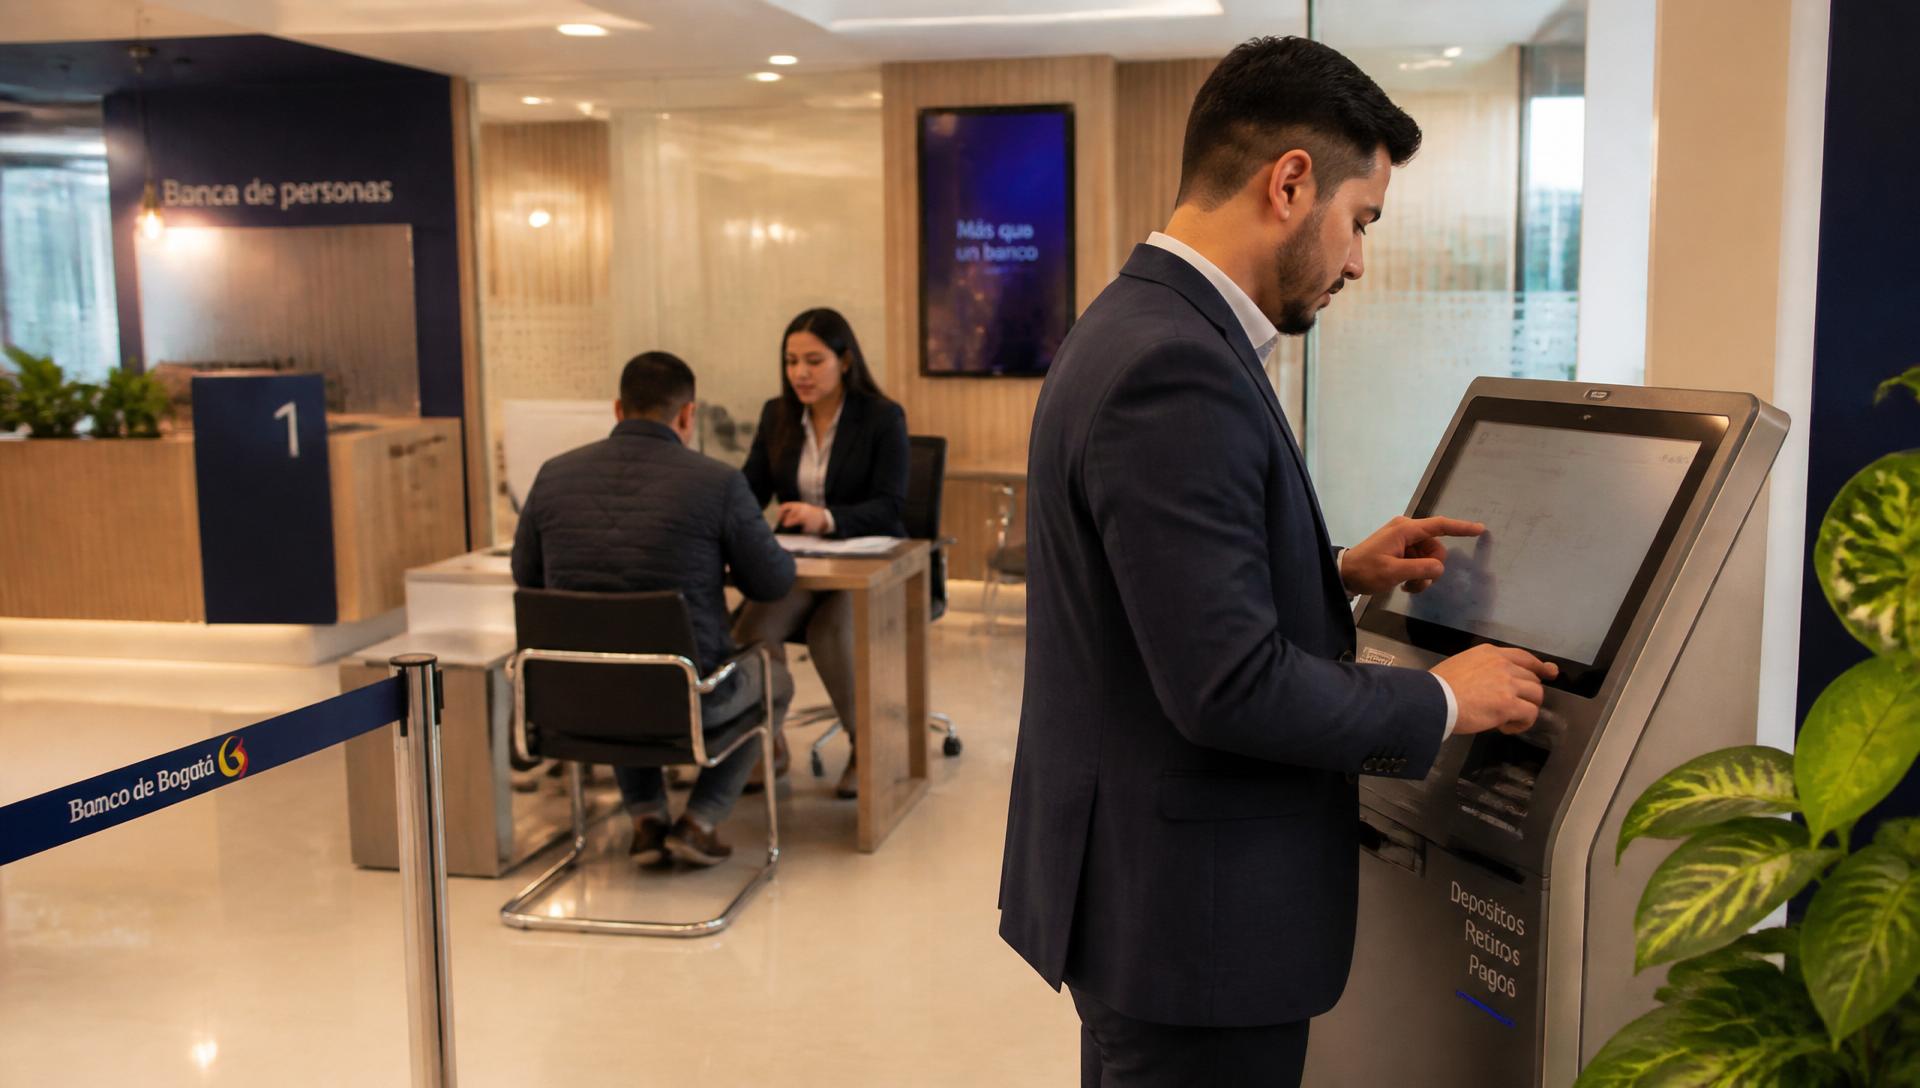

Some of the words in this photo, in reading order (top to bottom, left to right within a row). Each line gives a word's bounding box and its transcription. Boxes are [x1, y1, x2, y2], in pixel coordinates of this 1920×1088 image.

[162, 178, 239, 206] Banca
[244, 177, 275, 205] de
[280, 180, 394, 211] personas
[956, 218, 996, 240] Más
[955, 246, 981, 262] un
[273, 401, 300, 458] 1
[133, 777, 155, 801] de
